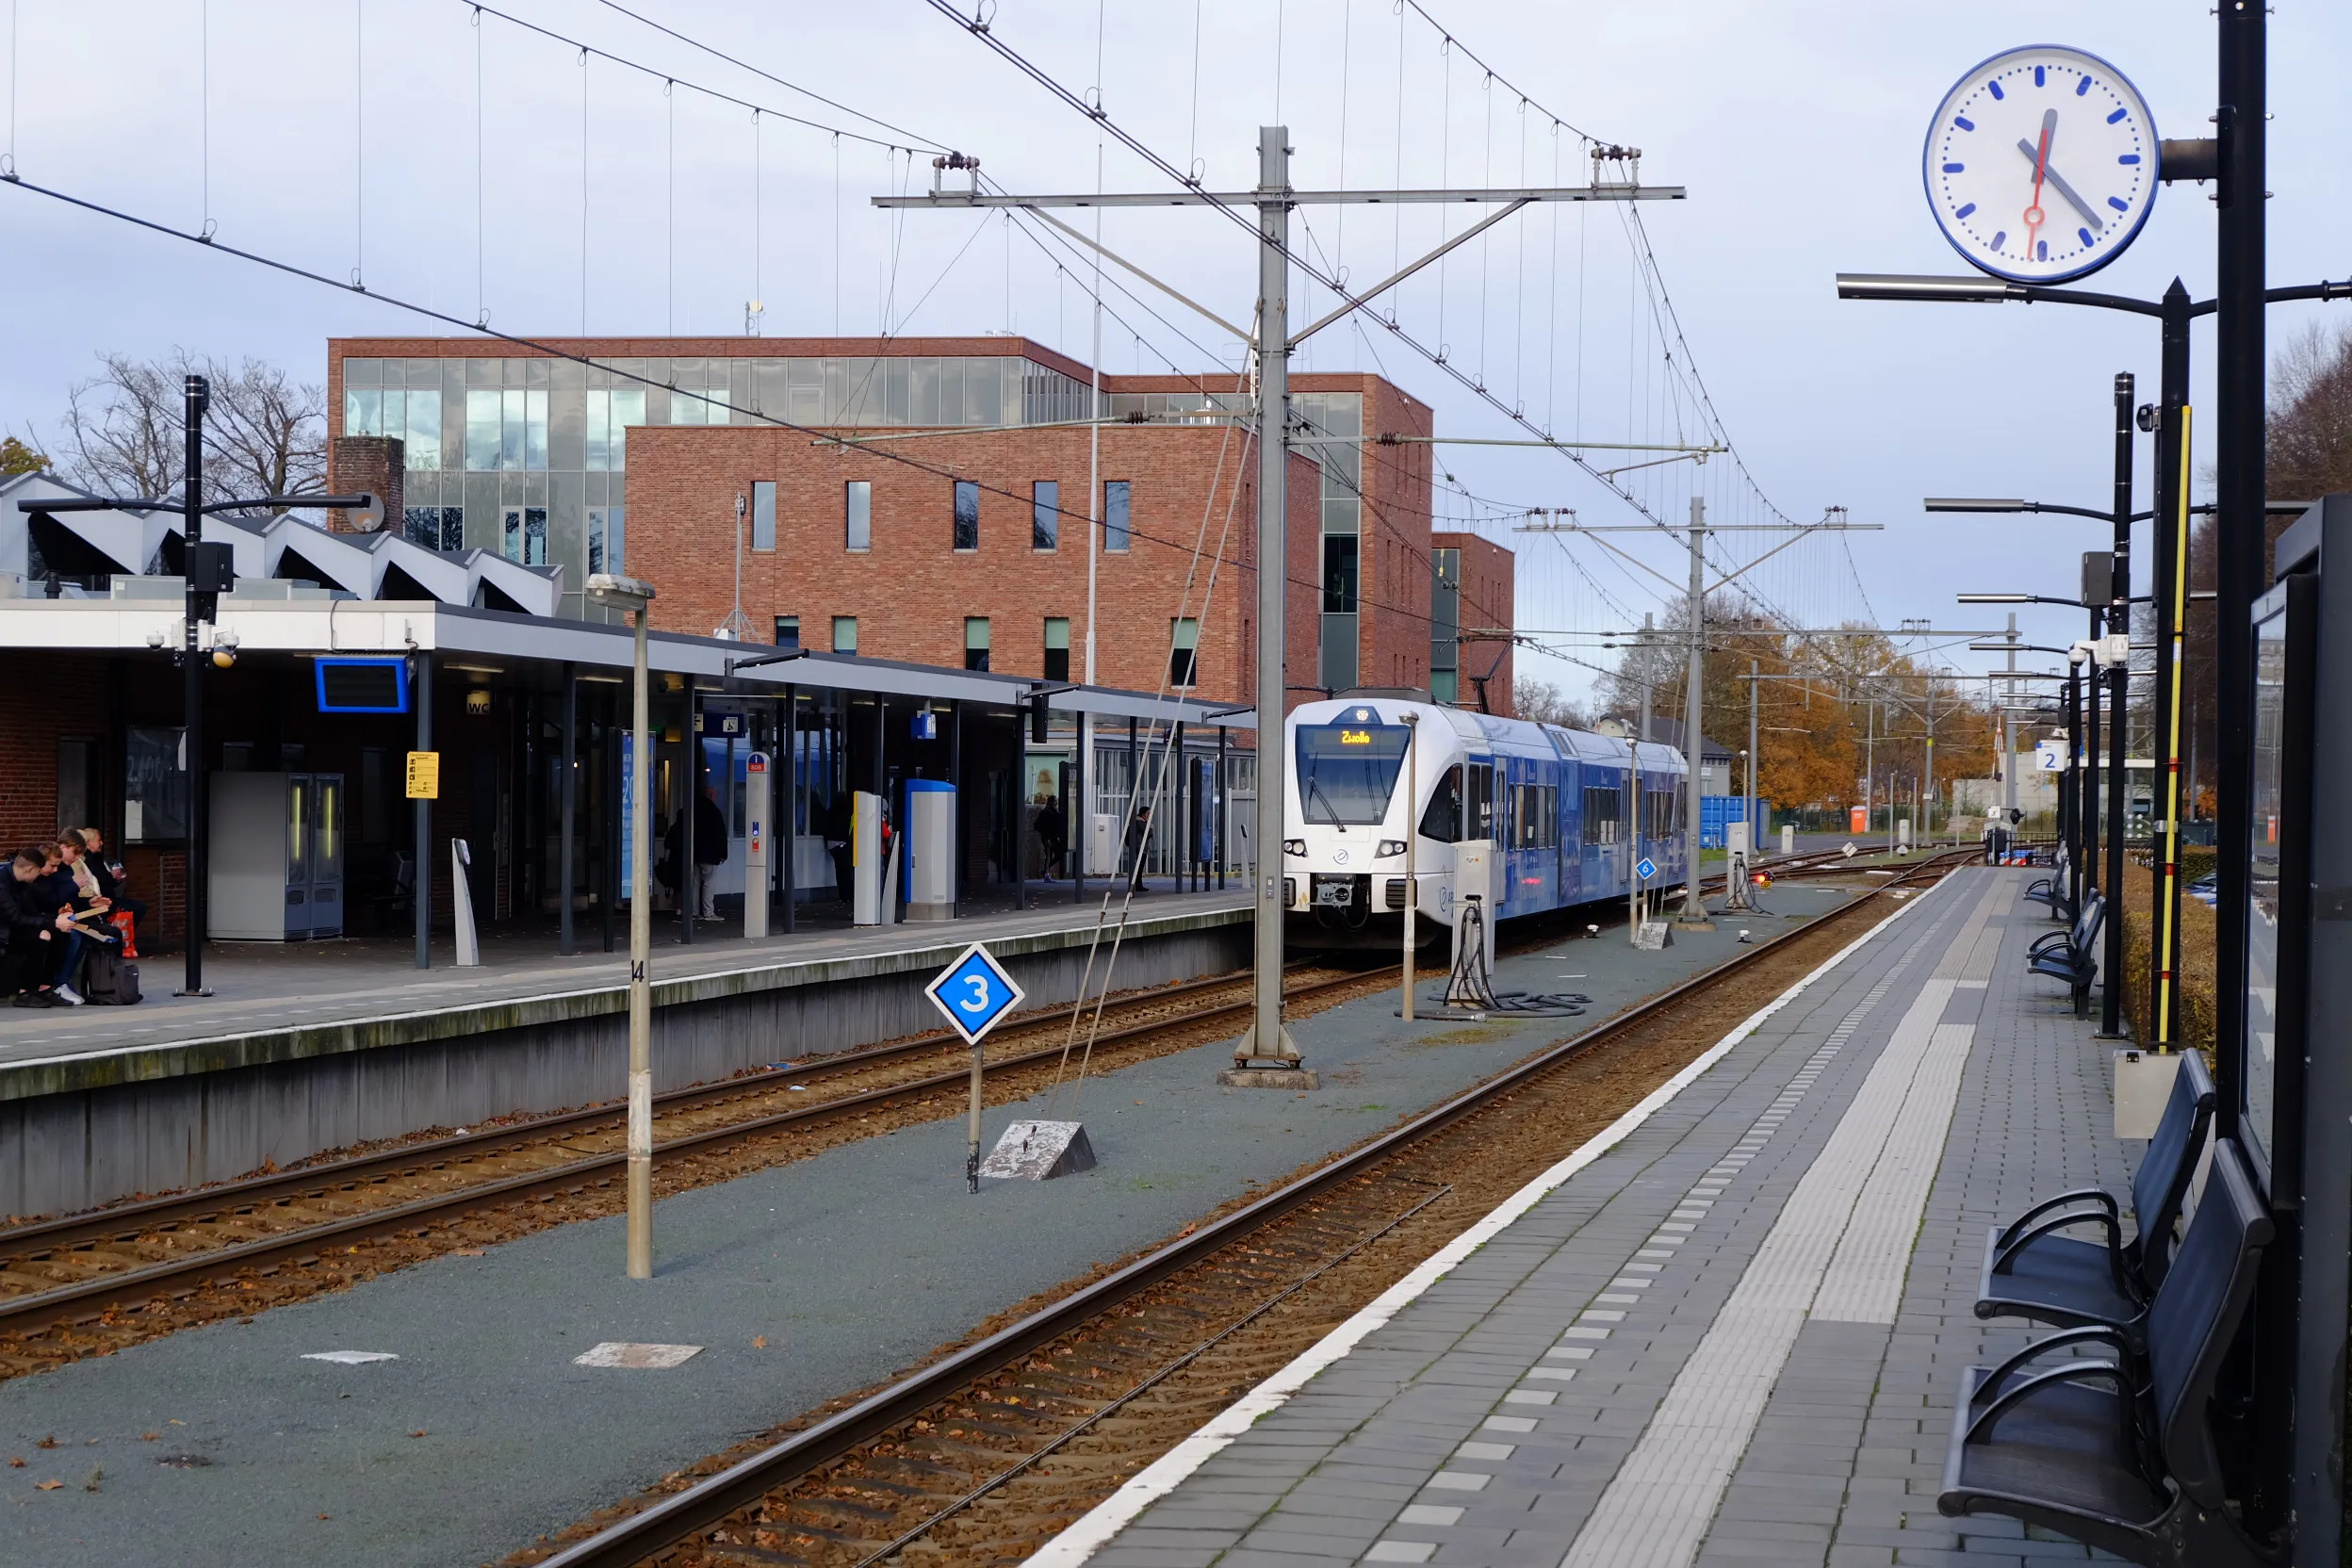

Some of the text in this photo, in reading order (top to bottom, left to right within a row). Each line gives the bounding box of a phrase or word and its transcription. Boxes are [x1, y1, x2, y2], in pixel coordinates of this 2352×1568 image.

[468, 702, 489, 713] WC
[1342, 730, 1370, 743] Zwolle
[2045, 753, 2056, 769] 2
[1642, 863, 1649, 874] 6
[630, 959, 645, 982] 14
[959, 974, 989, 1013] 3
